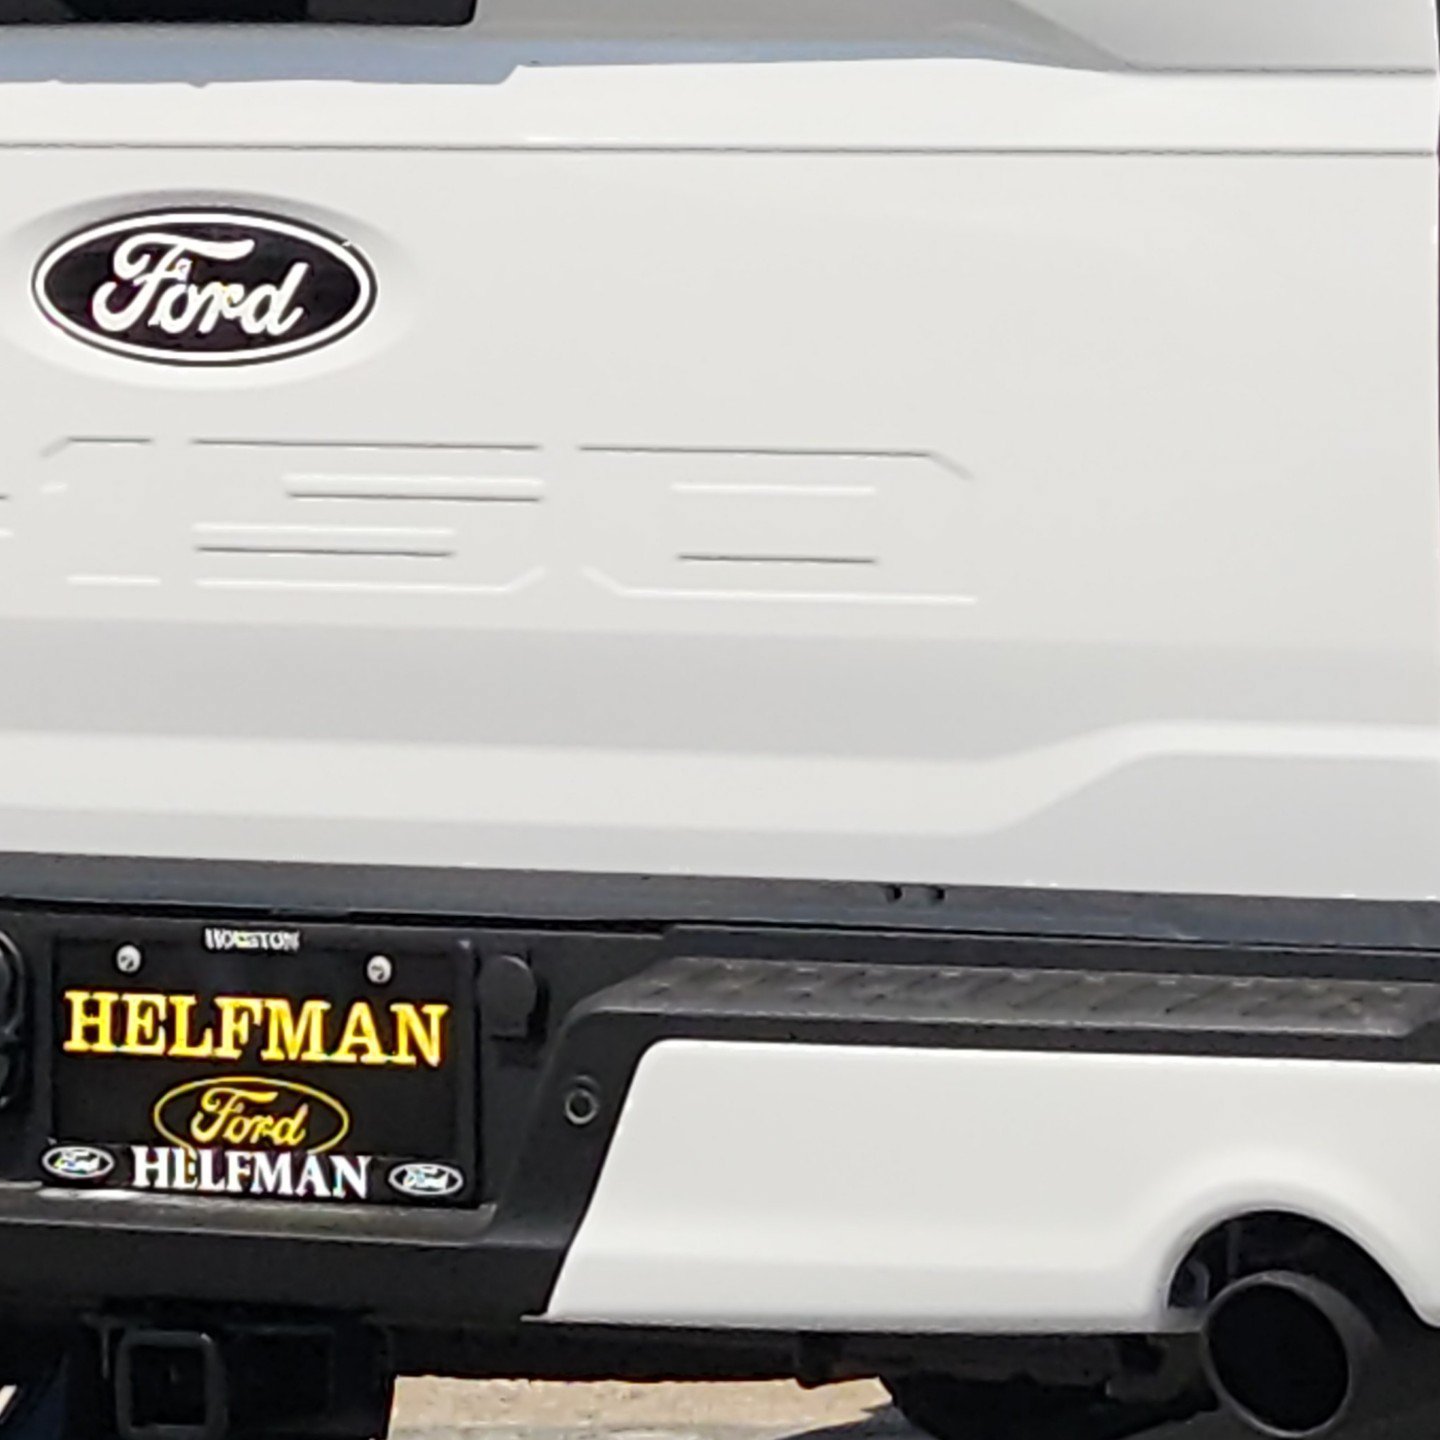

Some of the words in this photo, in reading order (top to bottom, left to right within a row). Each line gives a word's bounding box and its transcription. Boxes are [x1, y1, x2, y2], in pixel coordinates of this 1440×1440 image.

[91, 232, 309, 336] Ford
[63, 990, 449, 1067] HELFMAN
[190, 1086, 307, 1147] Ford
[131, 1145, 371, 1198] HELFMAN
